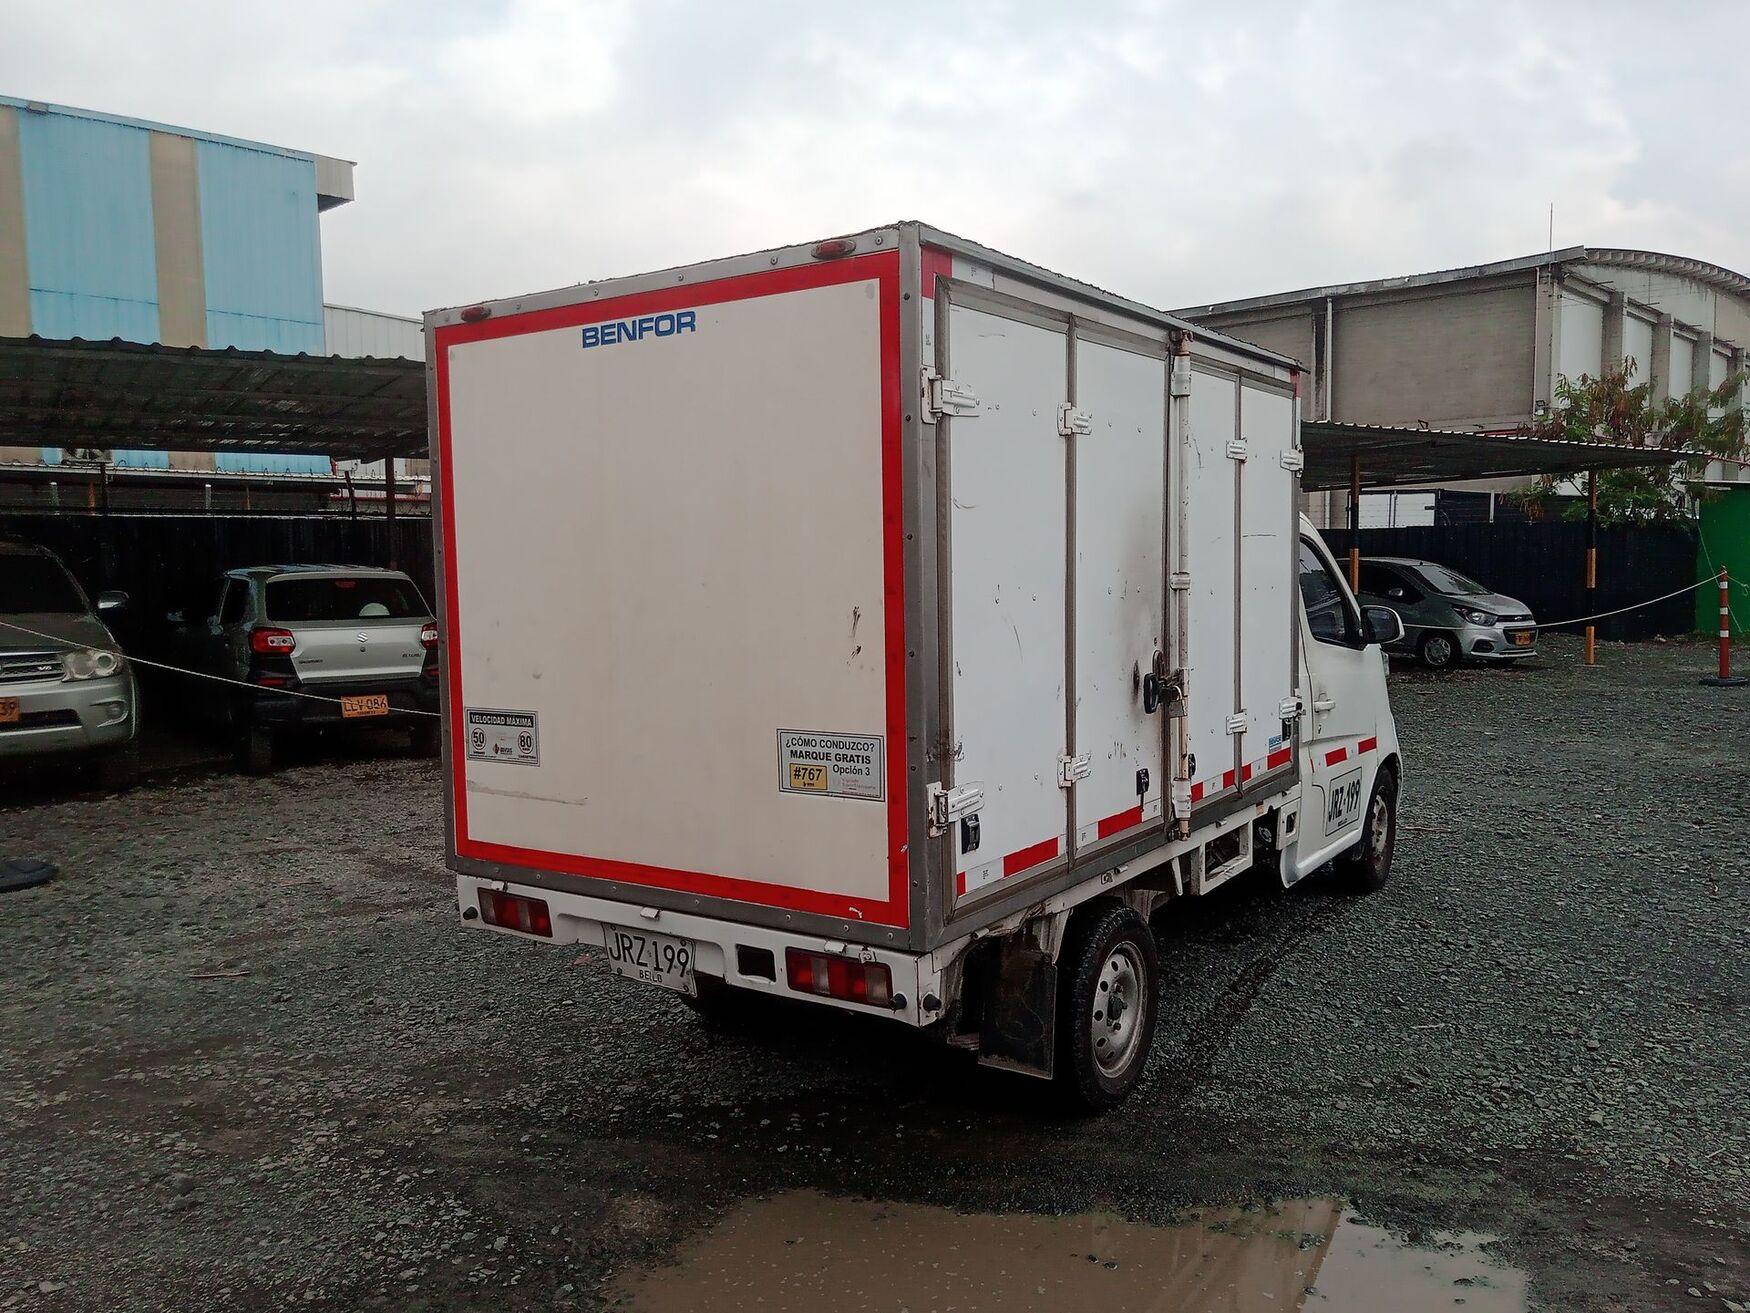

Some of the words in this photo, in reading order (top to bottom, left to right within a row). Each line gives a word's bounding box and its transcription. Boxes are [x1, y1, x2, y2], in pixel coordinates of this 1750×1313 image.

[582, 310, 696, 349] BENFOR
[471, 714, 505, 725] VELOCIDAD
[473, 732, 485, 744] 50
[520, 735, 532, 748] 80
[785, 736, 817, 748] ¿CÓMO
[819, 739, 875, 753] CONDUZCO?
[790, 750, 832, 761] MARQUE
[834, 753, 872, 765] GRATIS
[793, 766, 823, 781] #767
[832, 764, 863, 776] Opción
[865, 767, 871, 776] 3
[639, 969, 663, 983] BELLO
